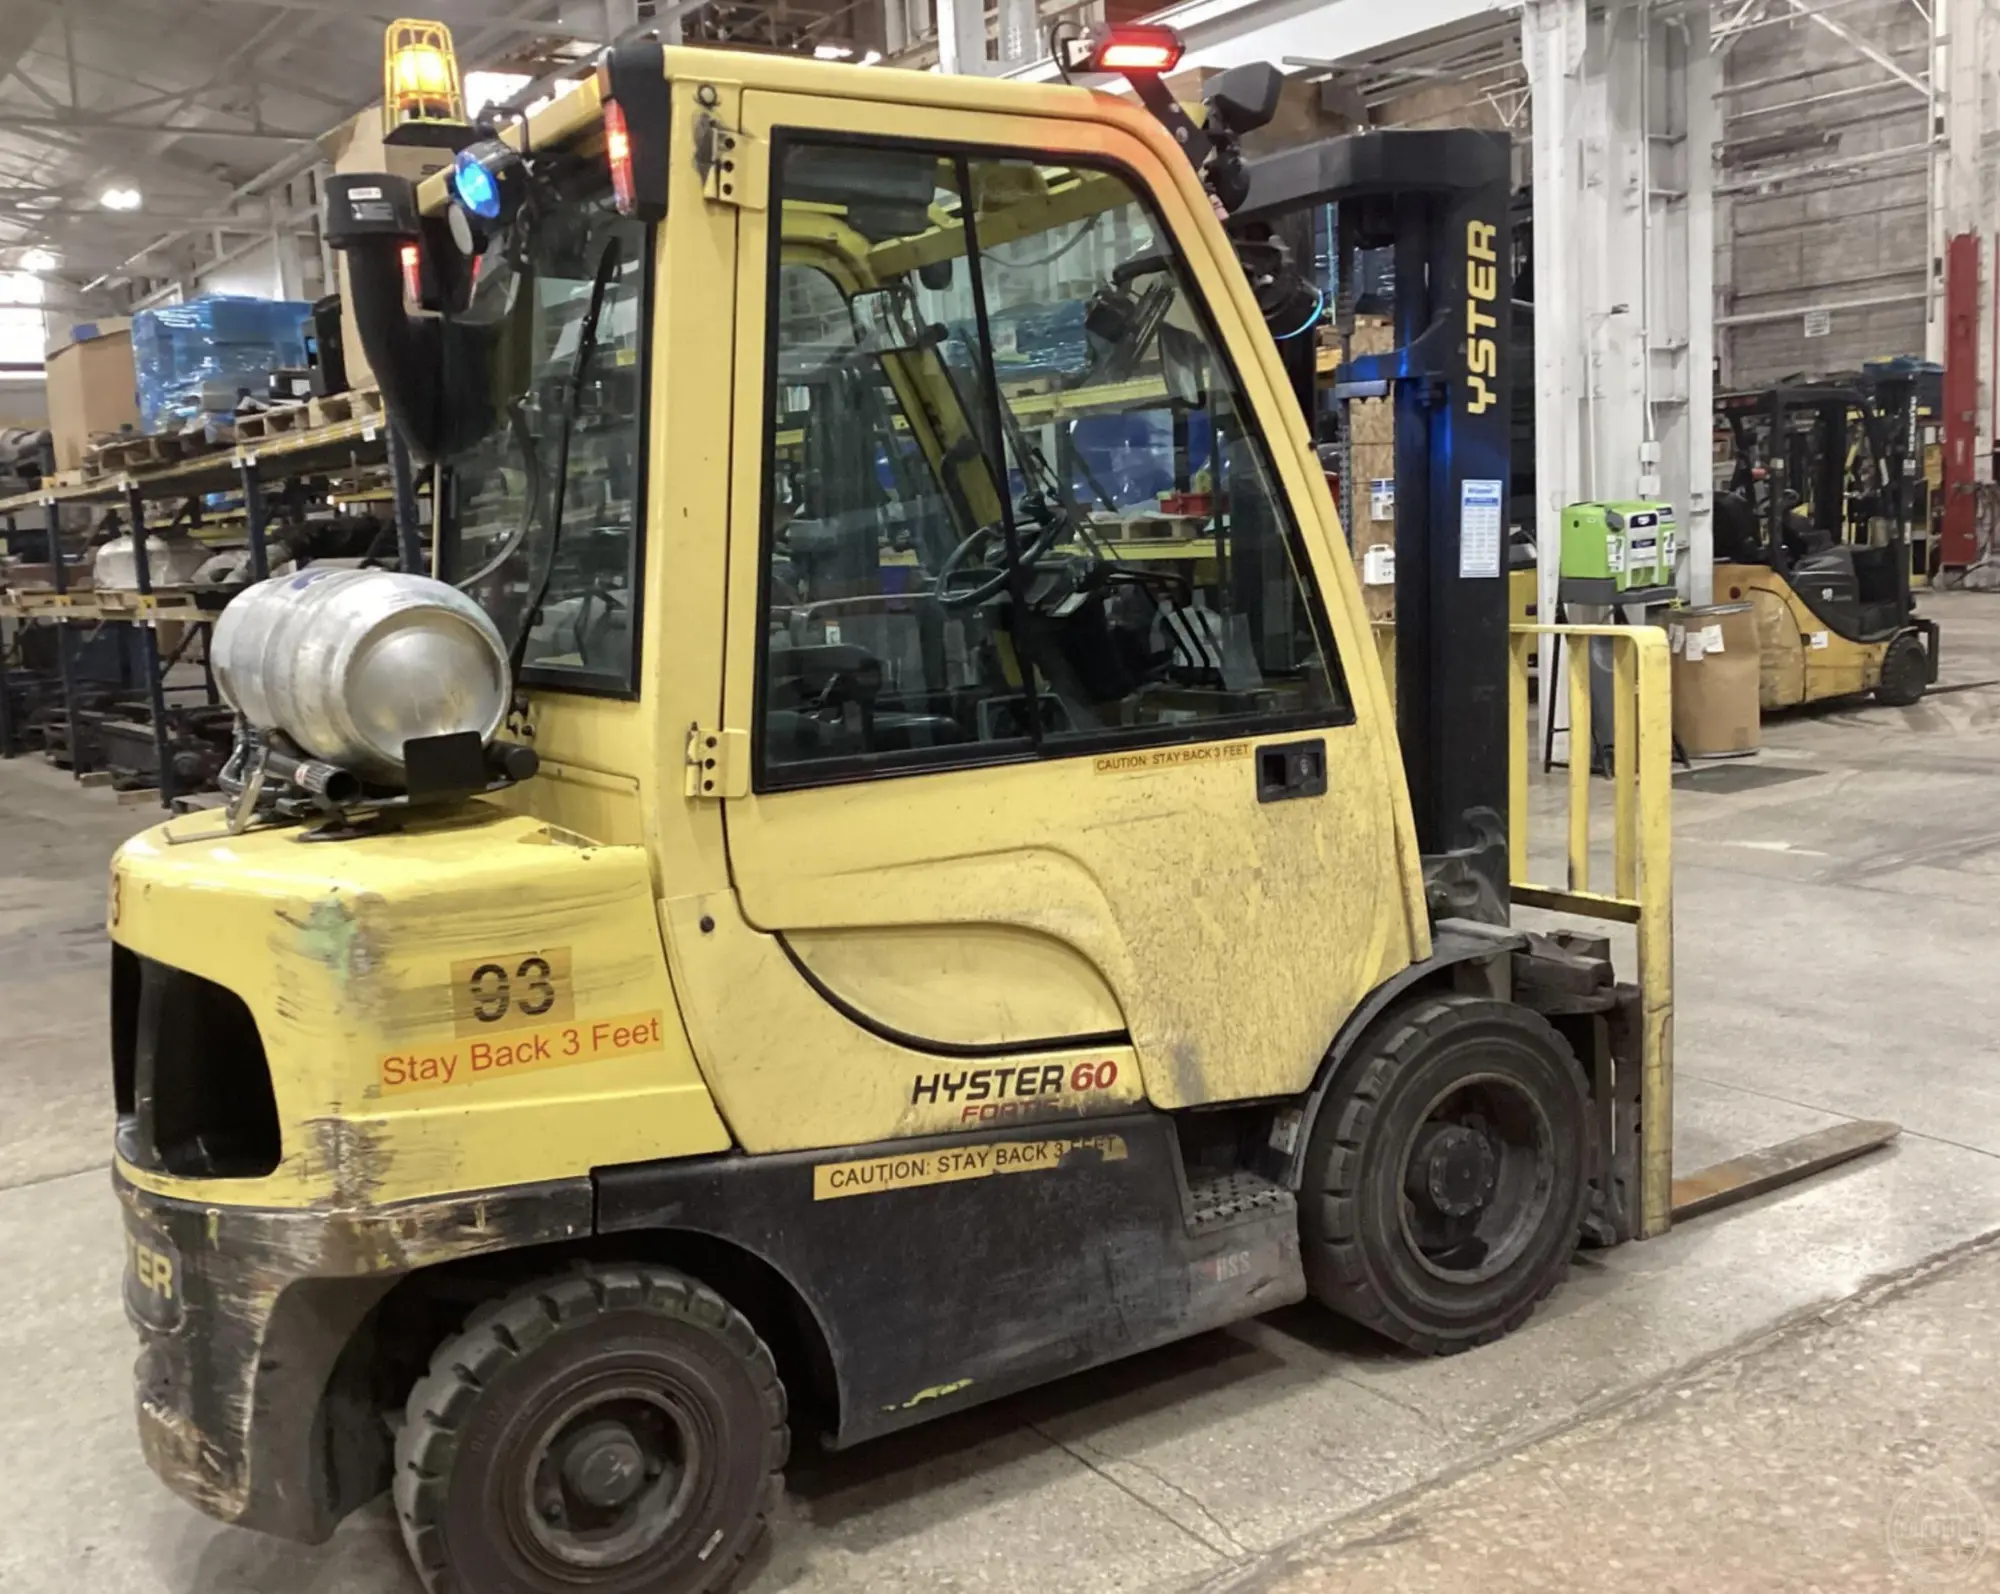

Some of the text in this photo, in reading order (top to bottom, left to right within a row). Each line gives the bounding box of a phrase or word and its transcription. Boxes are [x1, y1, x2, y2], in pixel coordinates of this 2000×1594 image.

[1467, 219, 1497, 414] YSTER
[1152, 751, 1181, 765] STAY
[1183, 748, 1212, 761] BACK
[1213, 748, 1221, 758] 3
[1222, 744, 1249, 757] FEET
[470, 957, 555, 1023] 93
[382, 1017, 661, 1085] Stay Back 3 Feet
[911, 1060, 1118, 1105] HYSTER 60
[829, 1162, 931, 1189] CAUTION:
[936, 1151, 990, 1174] STAY
[995, 1141, 1049, 1166] BACK
[1053, 1142, 1065, 1158] 3
